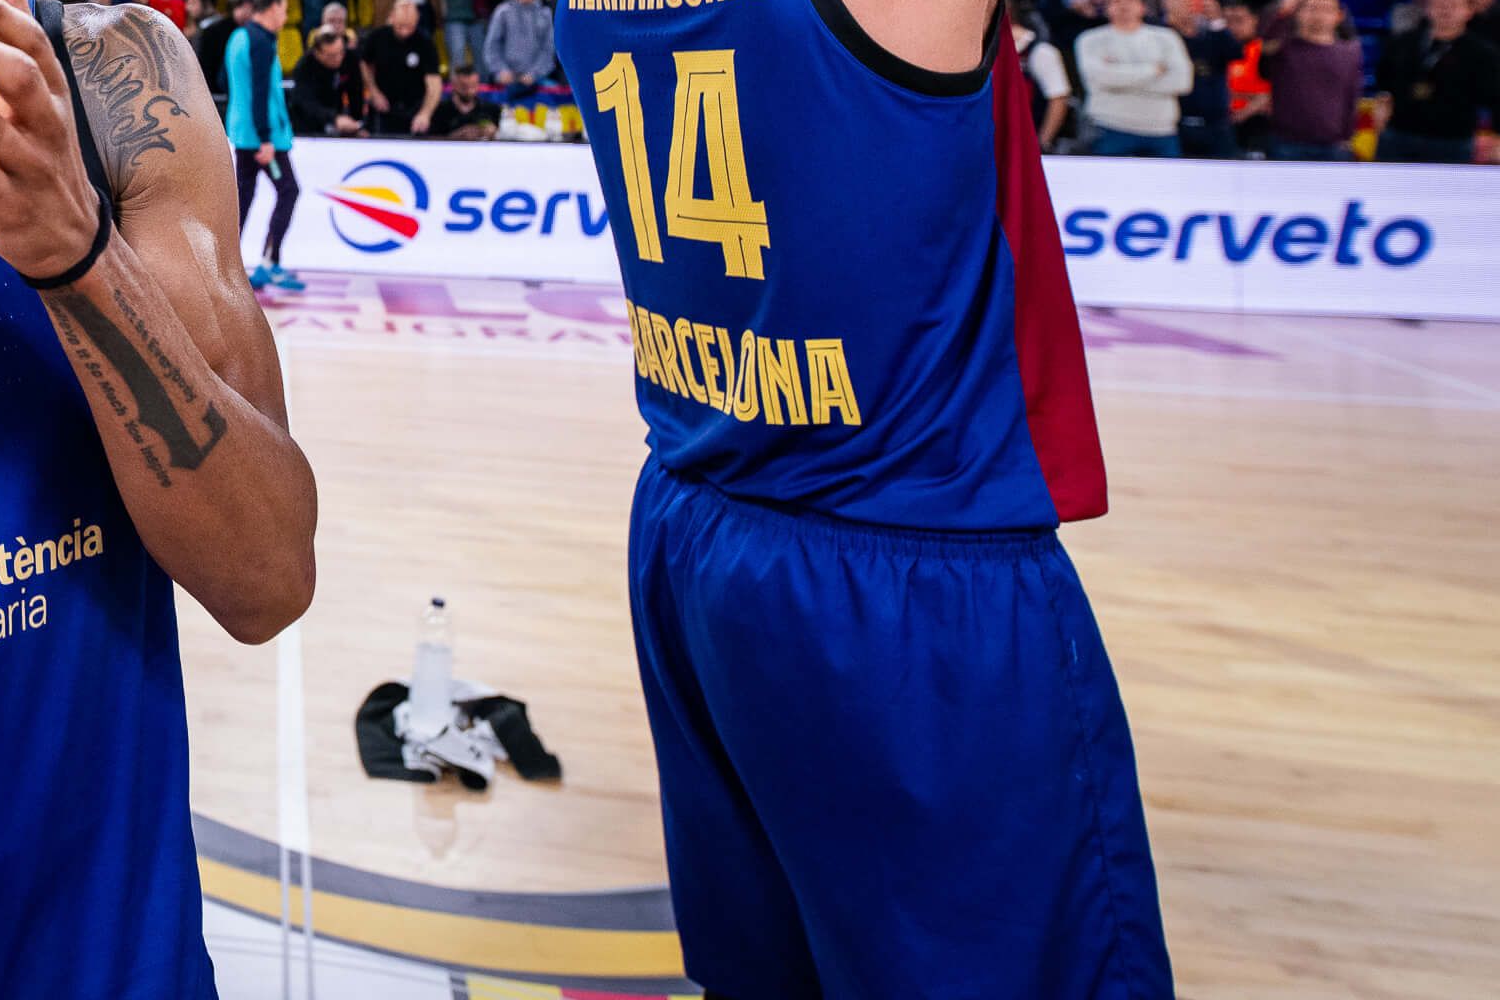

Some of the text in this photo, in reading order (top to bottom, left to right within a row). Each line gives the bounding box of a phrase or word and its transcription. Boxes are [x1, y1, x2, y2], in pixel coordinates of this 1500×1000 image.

[444, 189, 611, 238] serv
[593, 48, 771, 281] 14
[1064, 199, 1435, 269] serveto
[626, 298, 862, 426] BARCELONA
